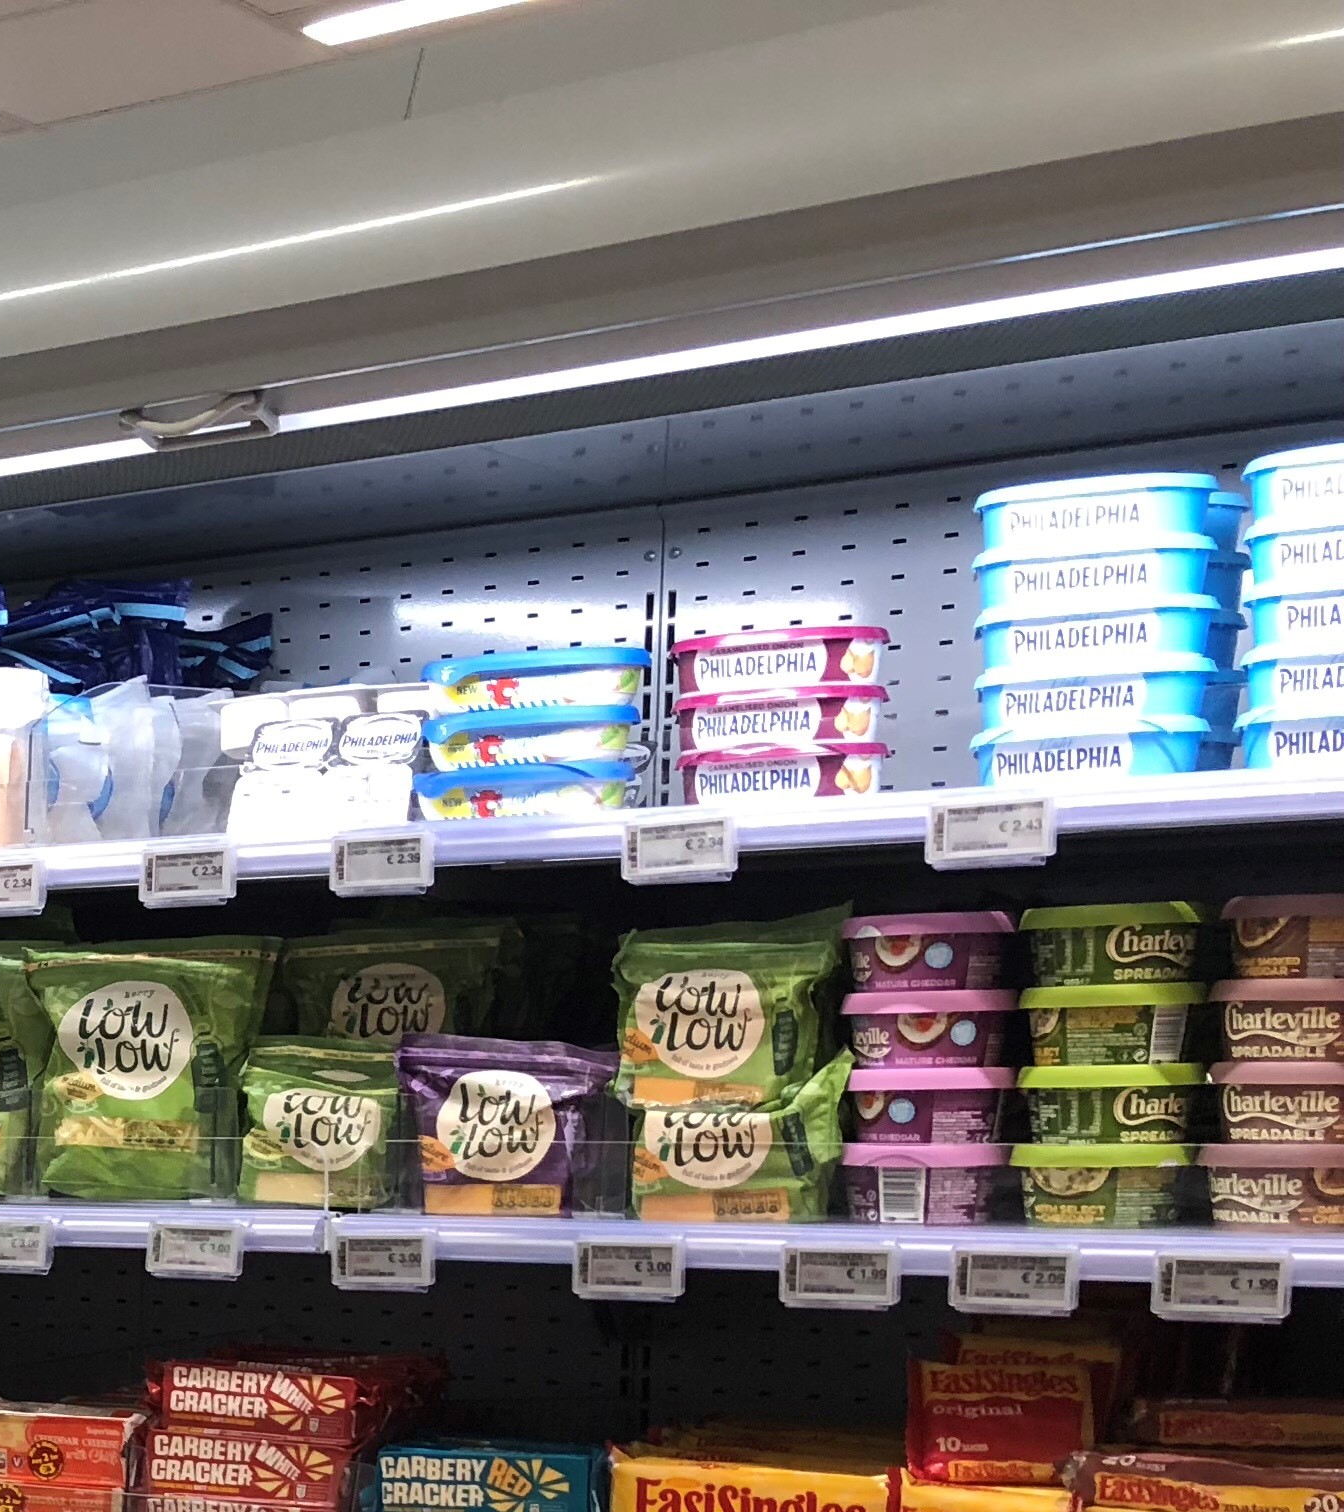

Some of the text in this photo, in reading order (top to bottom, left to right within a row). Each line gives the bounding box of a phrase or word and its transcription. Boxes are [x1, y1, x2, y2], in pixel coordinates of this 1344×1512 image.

[1013, 563, 1148, 594] PHILADELPHIA
[1013, 622, 1148, 654] PHILADELPHIA
[698, 649, 818, 681] PHILADELPHIA
[1005, 684, 1135, 720] PHILADELPHIA
[254, 737, 330, 756] PHILADELPHIA
[342, 732, 419, 749] PHILADELPHIA
[996, 745, 1122, 779] PHILADELPHIA
[697, 766, 812, 800] PHILADELPHIA
[1225, 1002, 1340, 1045] Charleville
[1231, 1045, 1325, 1057] SPREADABLE
[1223, 1086, 1339, 1129] Charleville
[1230, 1128, 1324, 1140] SPREADABLE
[173, 1366, 271, 1394] CARBERY
[270, 1371, 314, 1414] WHITE
[170, 1390, 268, 1419] CRACKER
[933, 1403, 1023, 1417] original
[153, 1435, 255, 1462] CARBERY
[255, 1441, 301, 1482] WHITE
[151, 1459, 251, 1487] CRACKER
[381, 1457, 488, 1481] CARBERY
[487, 1457, 531, 1499] RED
[381, 1483, 484, 1507] CRACKER
